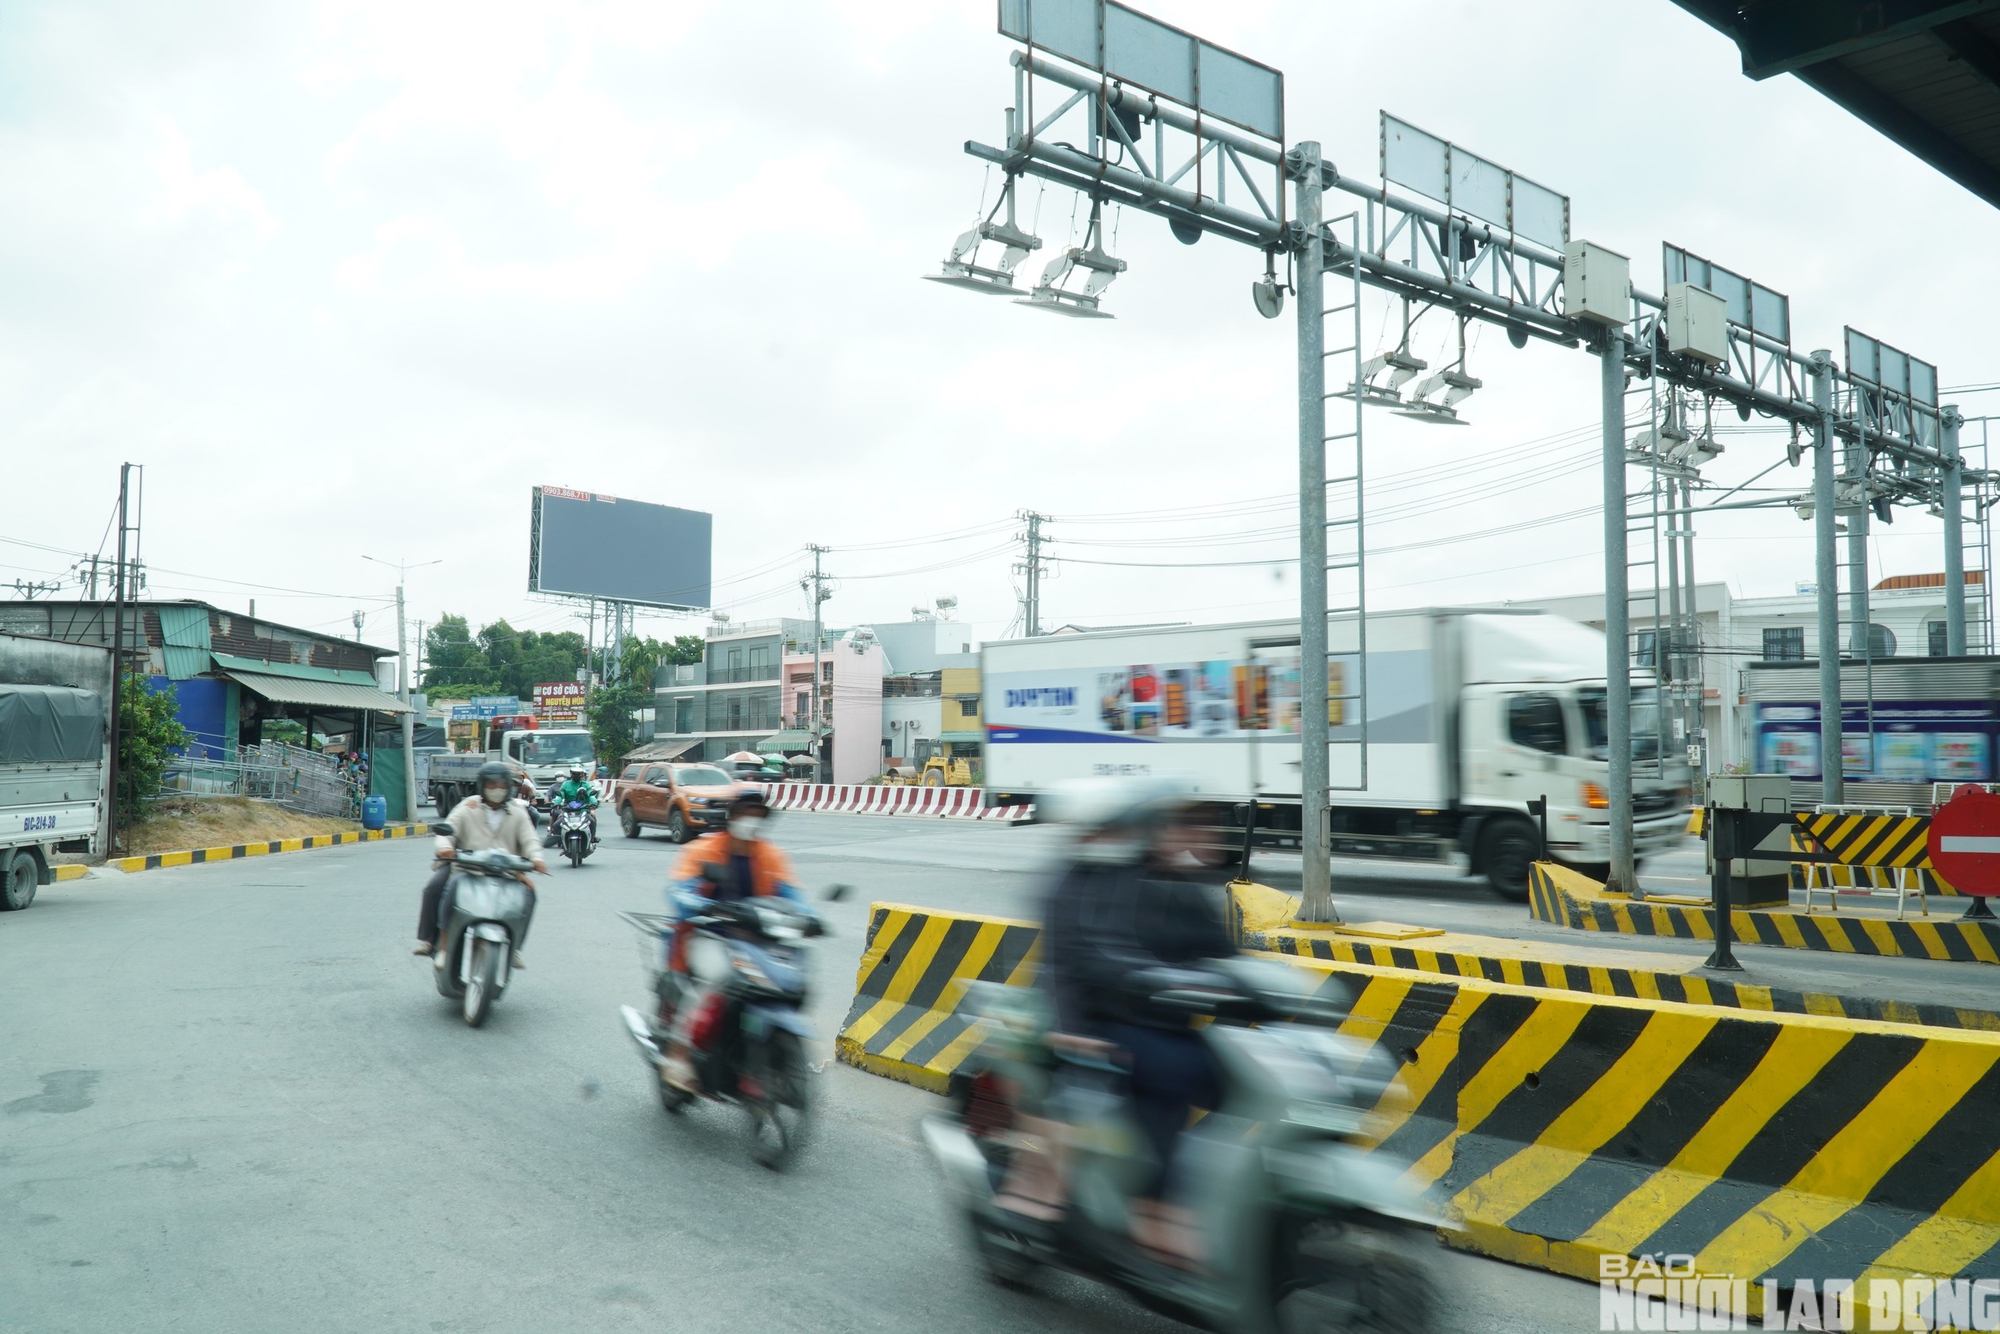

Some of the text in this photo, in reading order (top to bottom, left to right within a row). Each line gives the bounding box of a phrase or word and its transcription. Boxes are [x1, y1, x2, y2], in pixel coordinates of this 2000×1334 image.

[543, 486, 588, 500] 0903.868.711
[542, 686, 552, 695] CƠ
[553, 684, 563, 695] SỞ
[564, 684, 578, 695] CỬA
